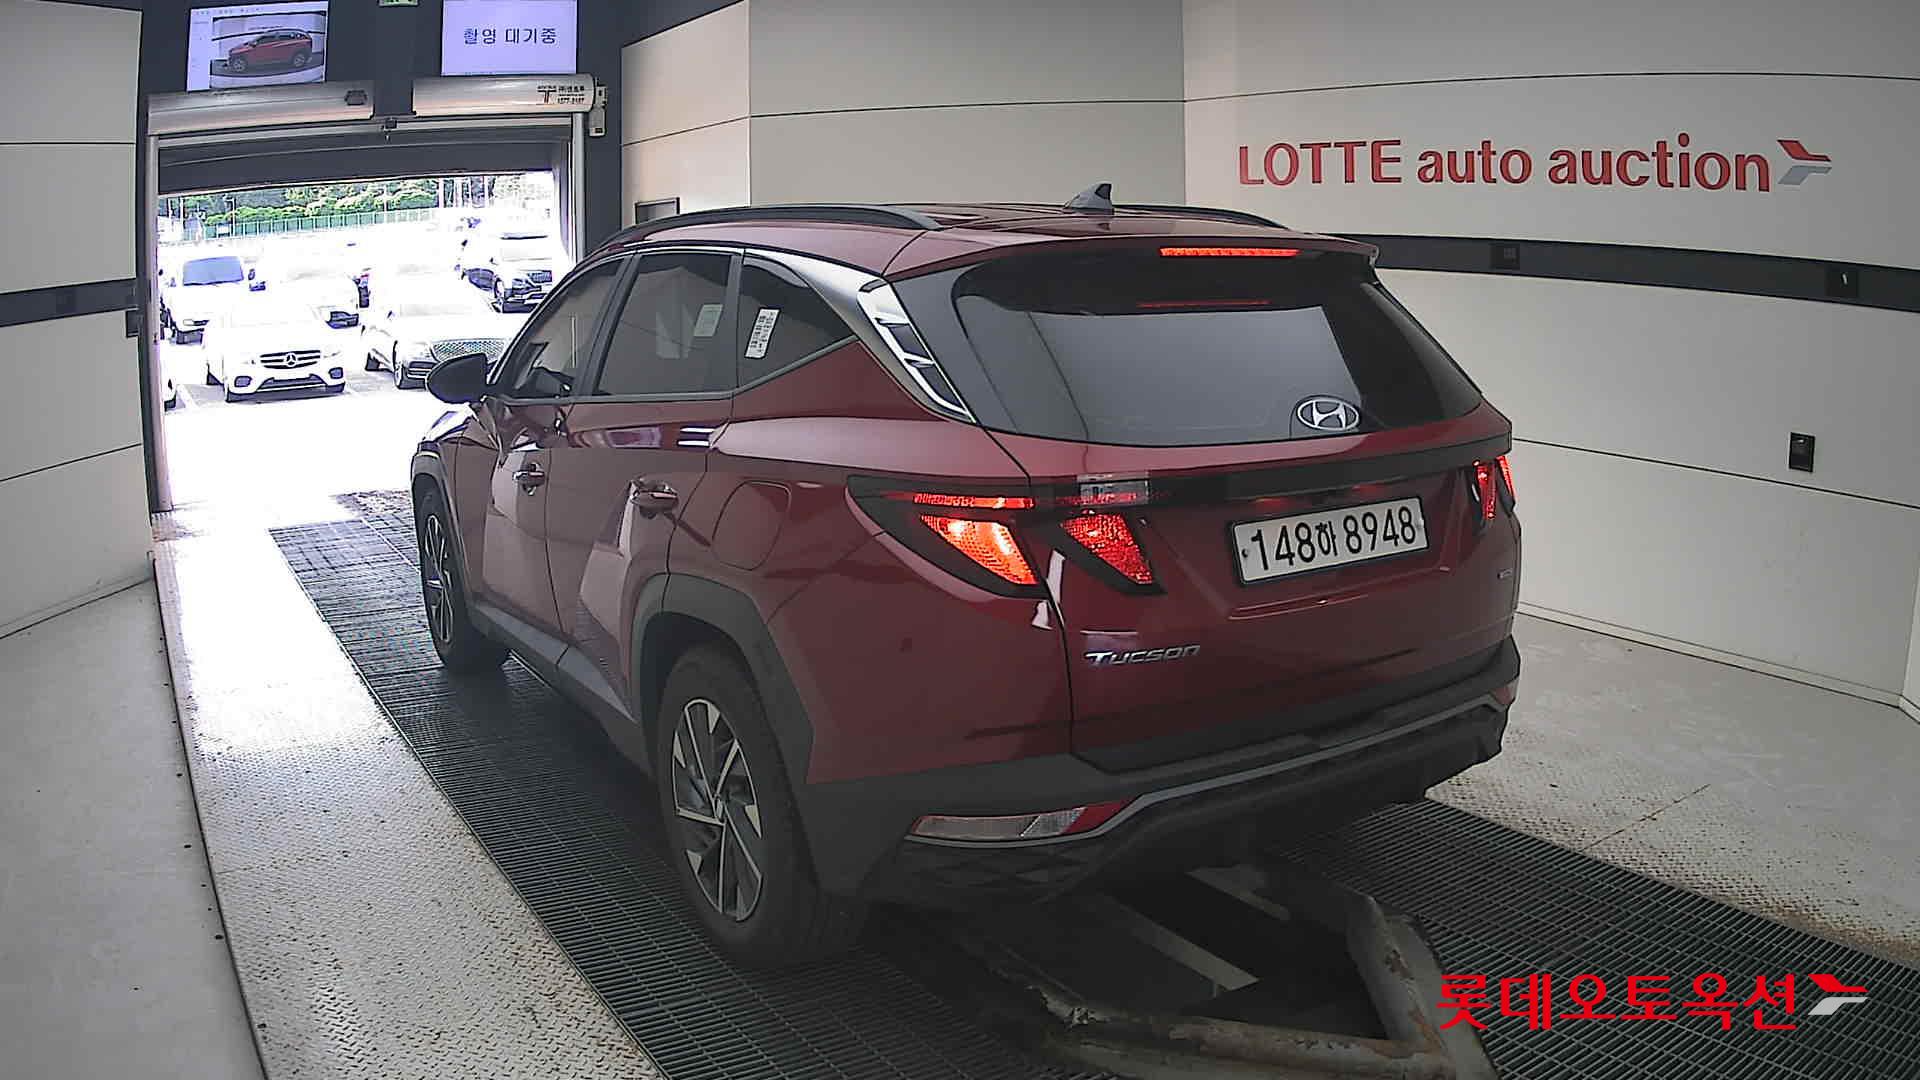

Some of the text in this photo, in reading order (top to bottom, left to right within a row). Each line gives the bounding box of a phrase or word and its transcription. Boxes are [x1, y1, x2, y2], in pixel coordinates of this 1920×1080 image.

[504, 27, 557, 45] 대기중
[1238, 132, 1771, 193] LOTTE auto auction
